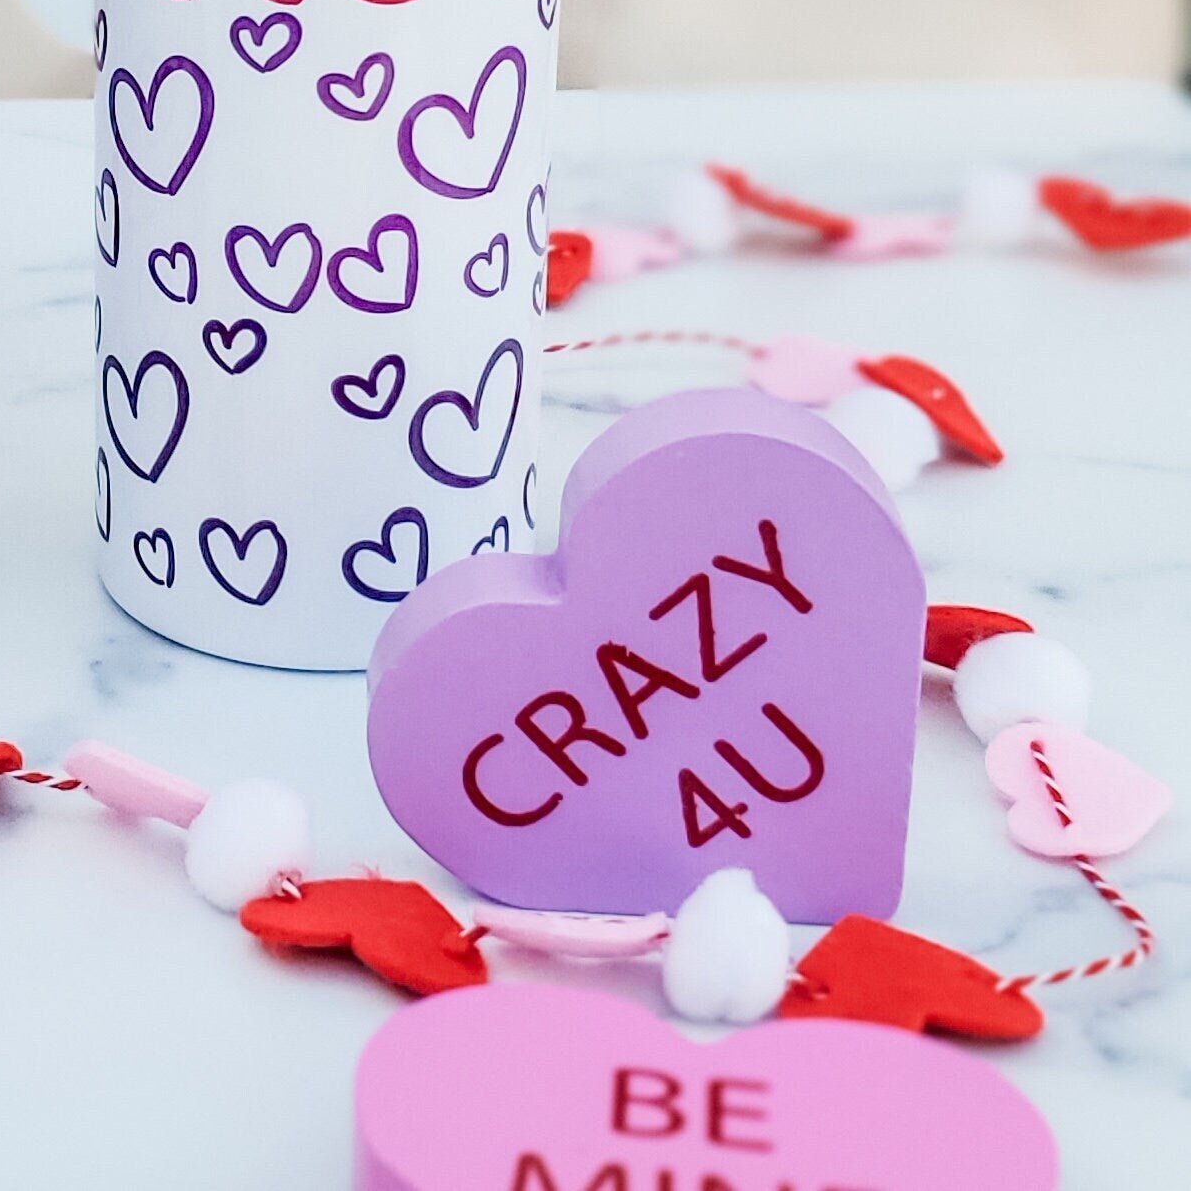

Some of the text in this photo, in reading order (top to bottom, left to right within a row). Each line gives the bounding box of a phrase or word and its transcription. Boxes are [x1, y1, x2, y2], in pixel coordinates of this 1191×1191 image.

[462, 519, 813, 827] CRAZY
[679, 703, 824, 848] 4U
[611, 1066, 773, 1153] BE
